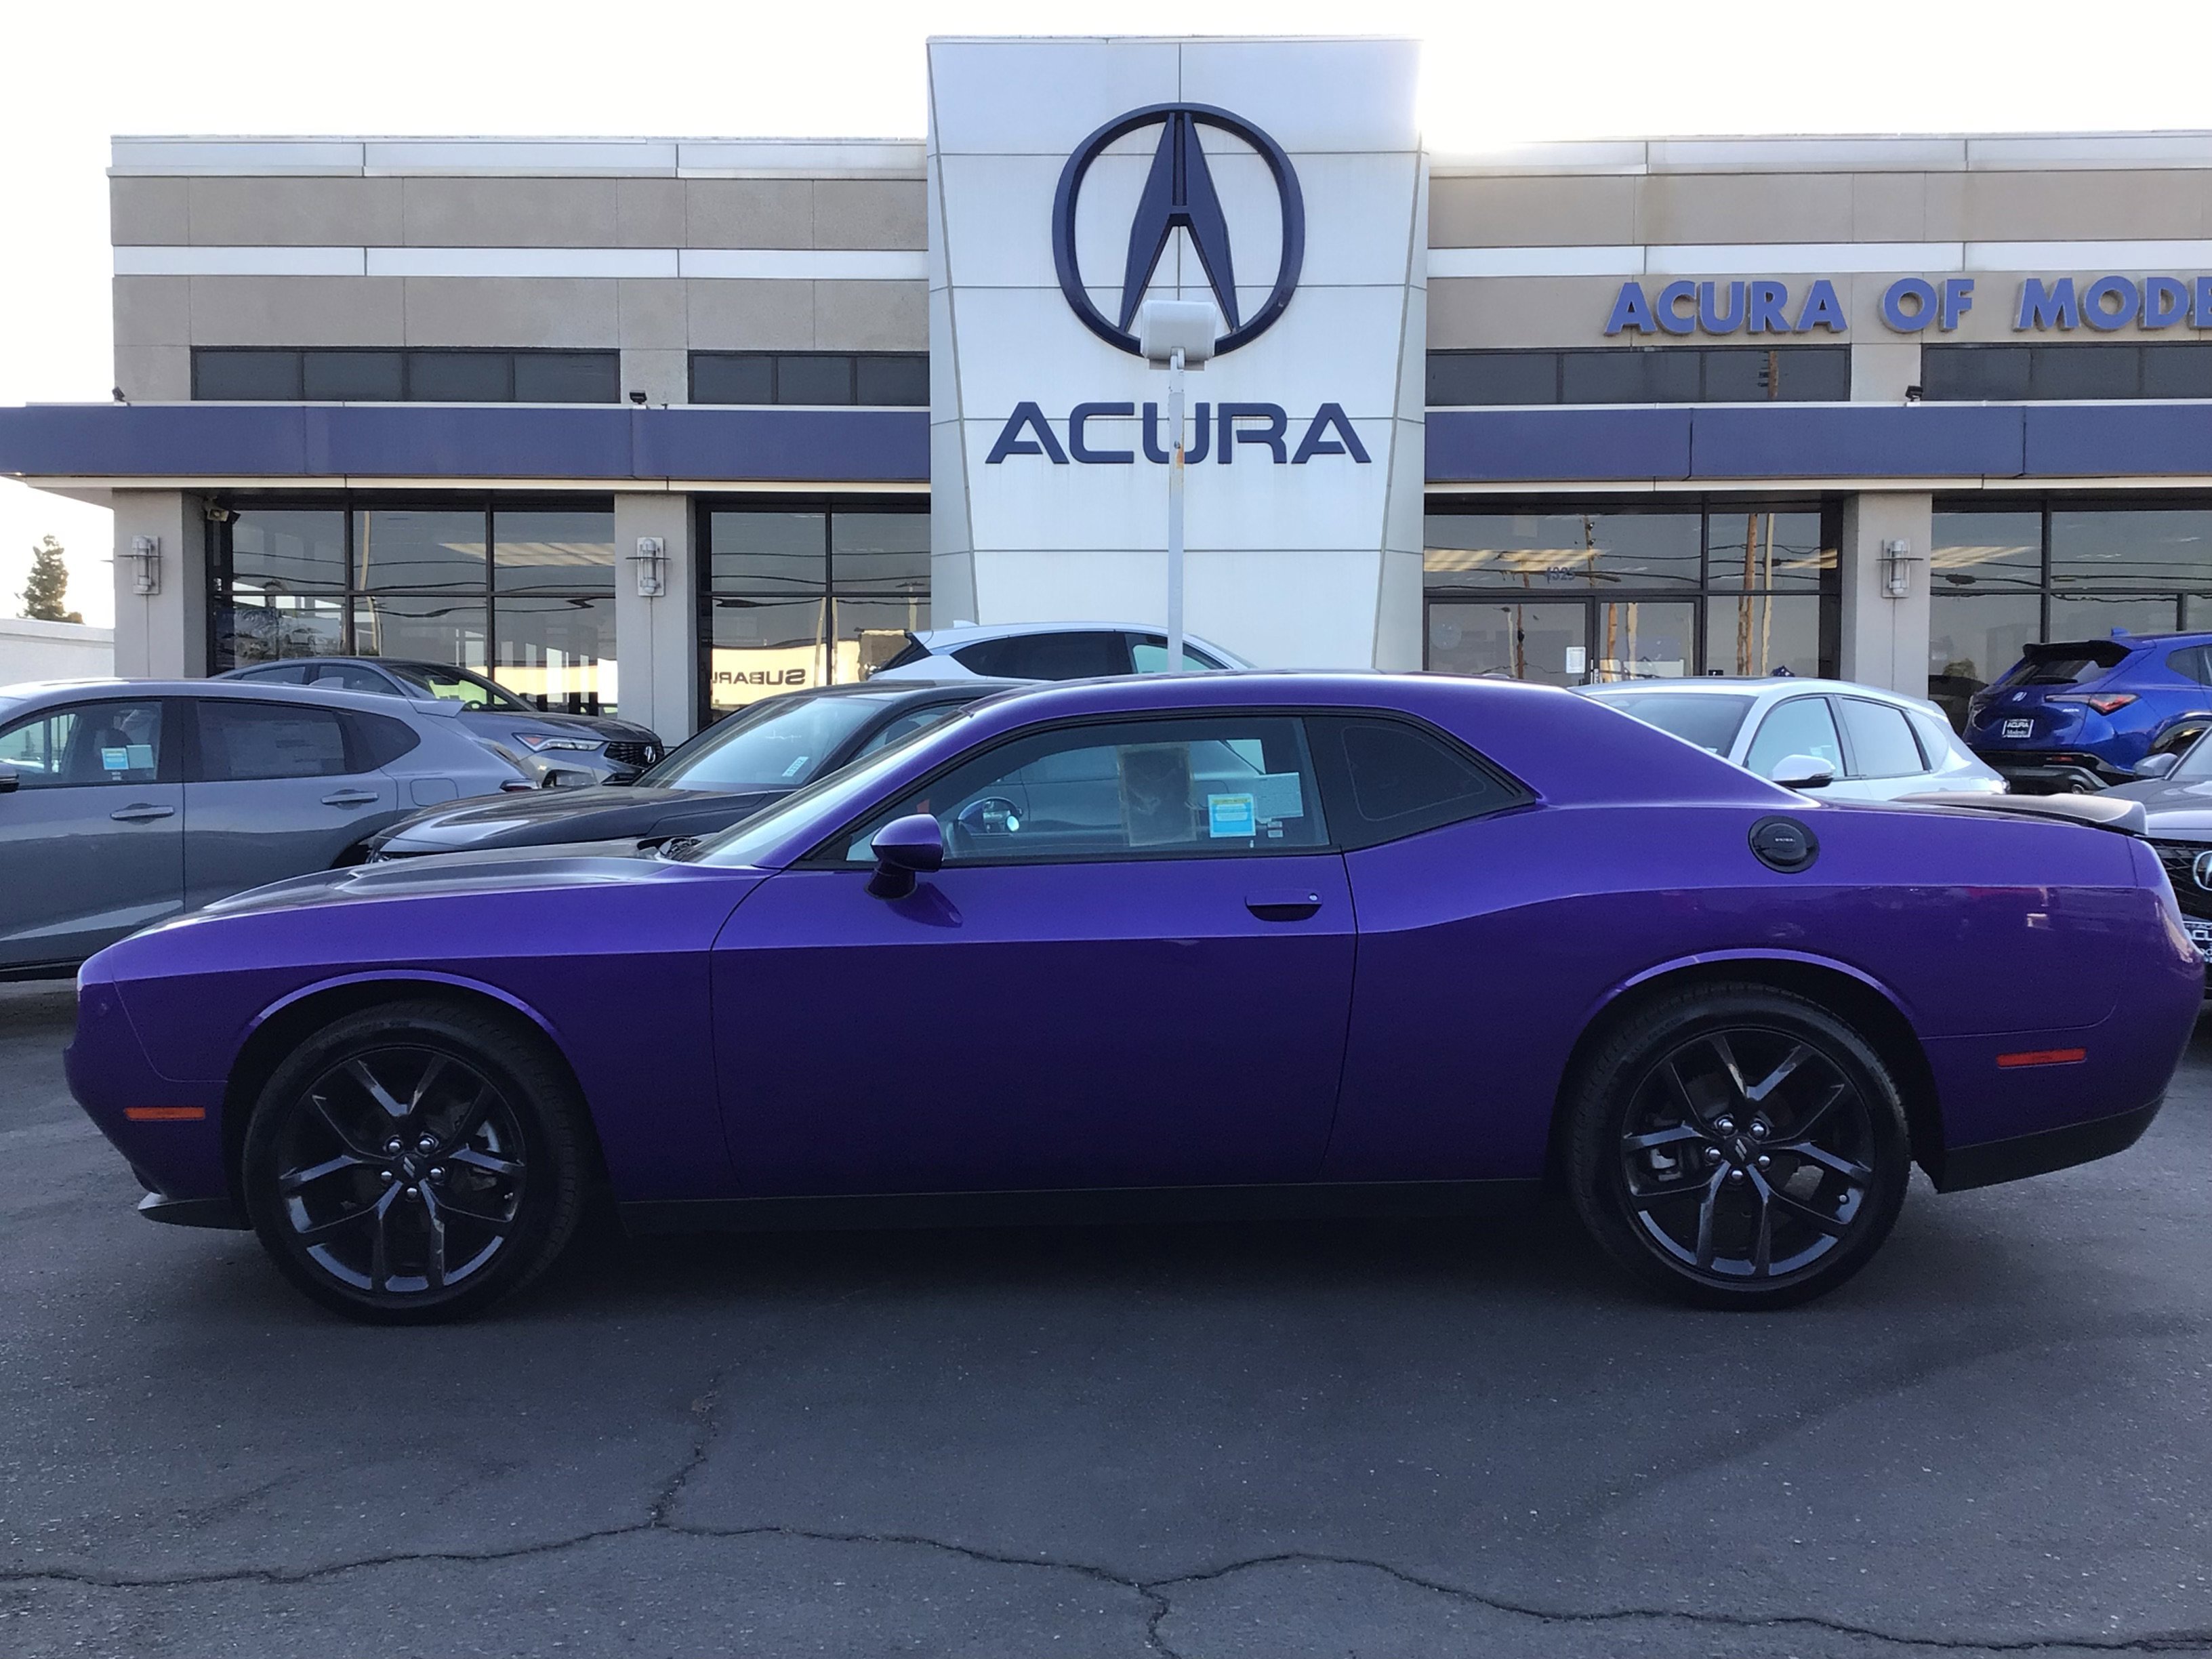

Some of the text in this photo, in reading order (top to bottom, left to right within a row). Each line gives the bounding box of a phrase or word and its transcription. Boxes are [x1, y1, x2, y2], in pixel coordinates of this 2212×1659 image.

[1603, 279, 1849, 337] ACURA
[1879, 277, 1975, 333] OF
[985, 401, 1372, 464] ACURA
